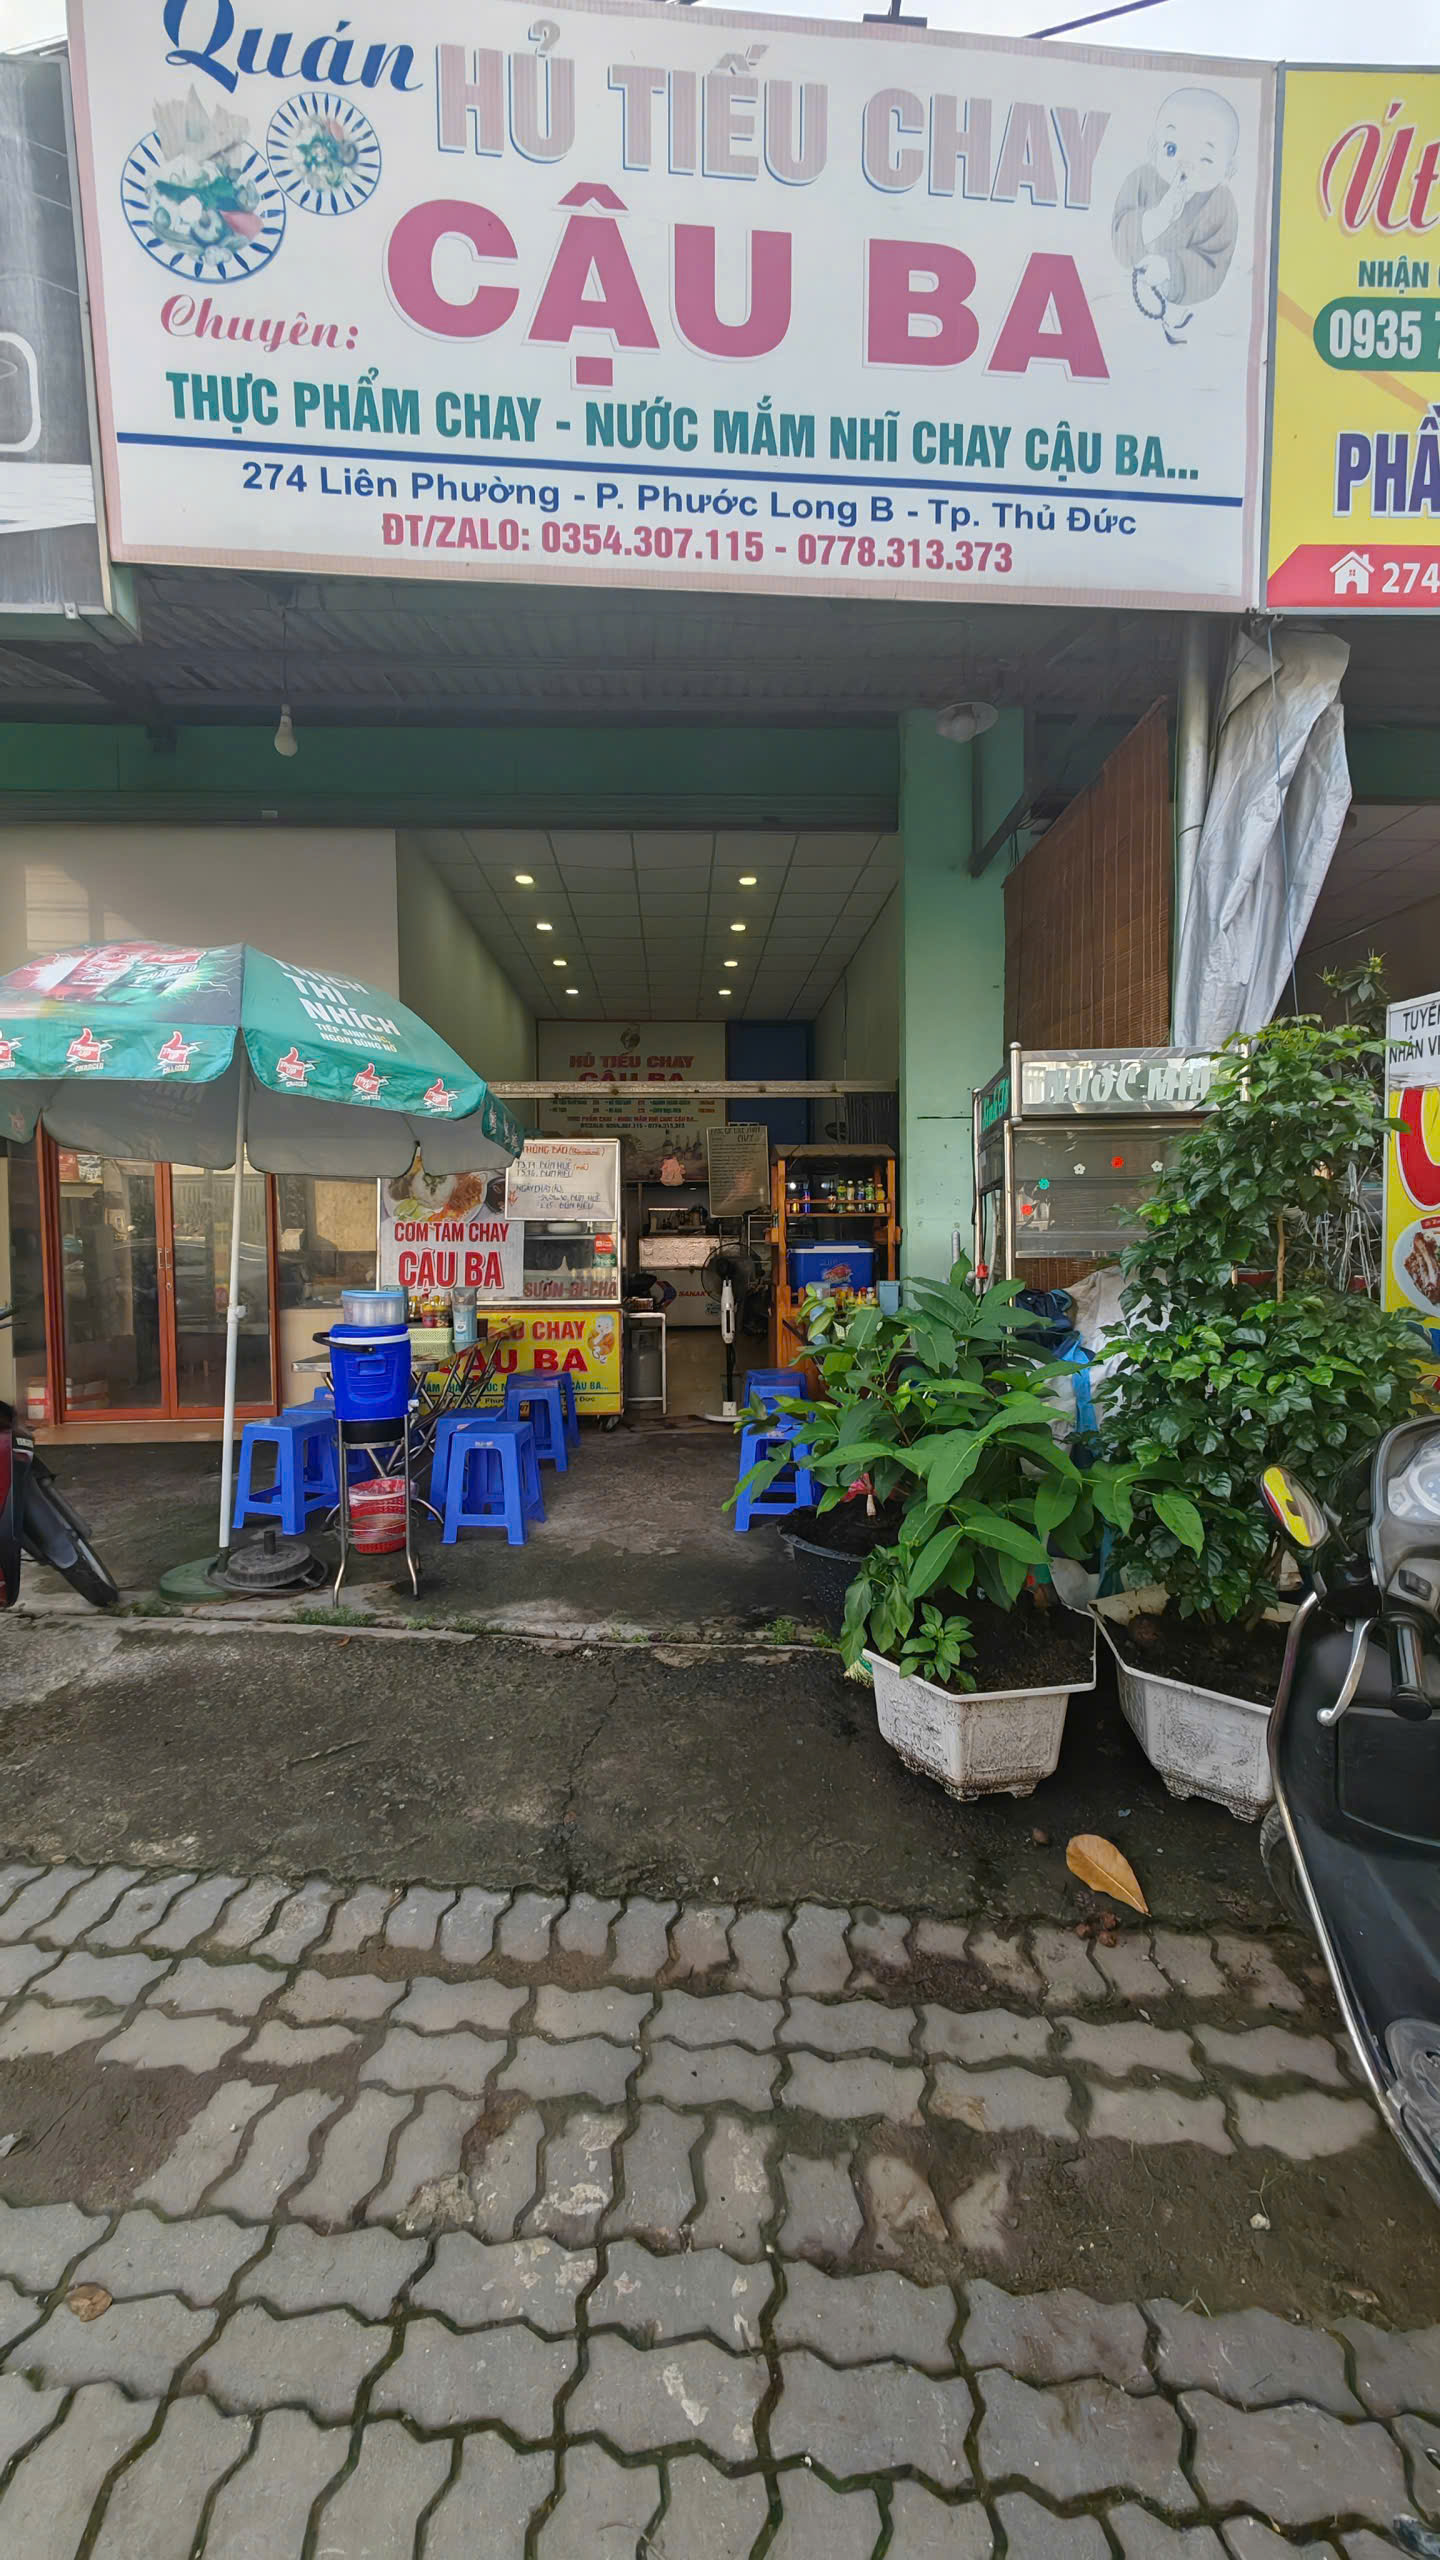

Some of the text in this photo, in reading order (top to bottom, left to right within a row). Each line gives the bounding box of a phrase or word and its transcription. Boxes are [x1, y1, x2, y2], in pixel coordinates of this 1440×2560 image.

[162, 0, 424, 94] Quán
[435, 19, 1111, 210] HỦ TIẾU CHAY
[382, 181, 1113, 391] CẬU BA
[1358, 255, 1429, 295] NHẬN
[160, 293, 359, 354] Chuyên:
[1329, 308, 1422, 360] 0935
[166, 366, 1199, 482] THỰC PHẨM CHAY - NƯỚC MẮM NHĨ CHAY CẬU BA...
[242, 461, 307, 493] 274
[320, 468, 398, 499] Liên
[411, 472, 560, 514] Phường
[596, 484, 624, 511] P.
[638, 484, 758, 520] Phước
[769, 494, 857, 528] Long
[871, 497, 895, 522] B
[928, 500, 981, 534] Tp.
[992, 501, 1055, 531] Thủ
[1066, 505, 1137, 536] Đức
[381, 513, 531, 553] ĐT/ZALO:
[541, 519, 764, 563] 0354.307.115
[796, 532, 1013, 573] 0778.313.373
[1381, 561, 1440, 594] 274
[646, 1055, 696, 1069] CHAY
[468, 1222, 509, 1243] CHAY
[397, 1246, 505, 1300] CẬU BA
[532, 1319, 586, 1341] CHAY
[533, 1347, 589, 1373] BA
